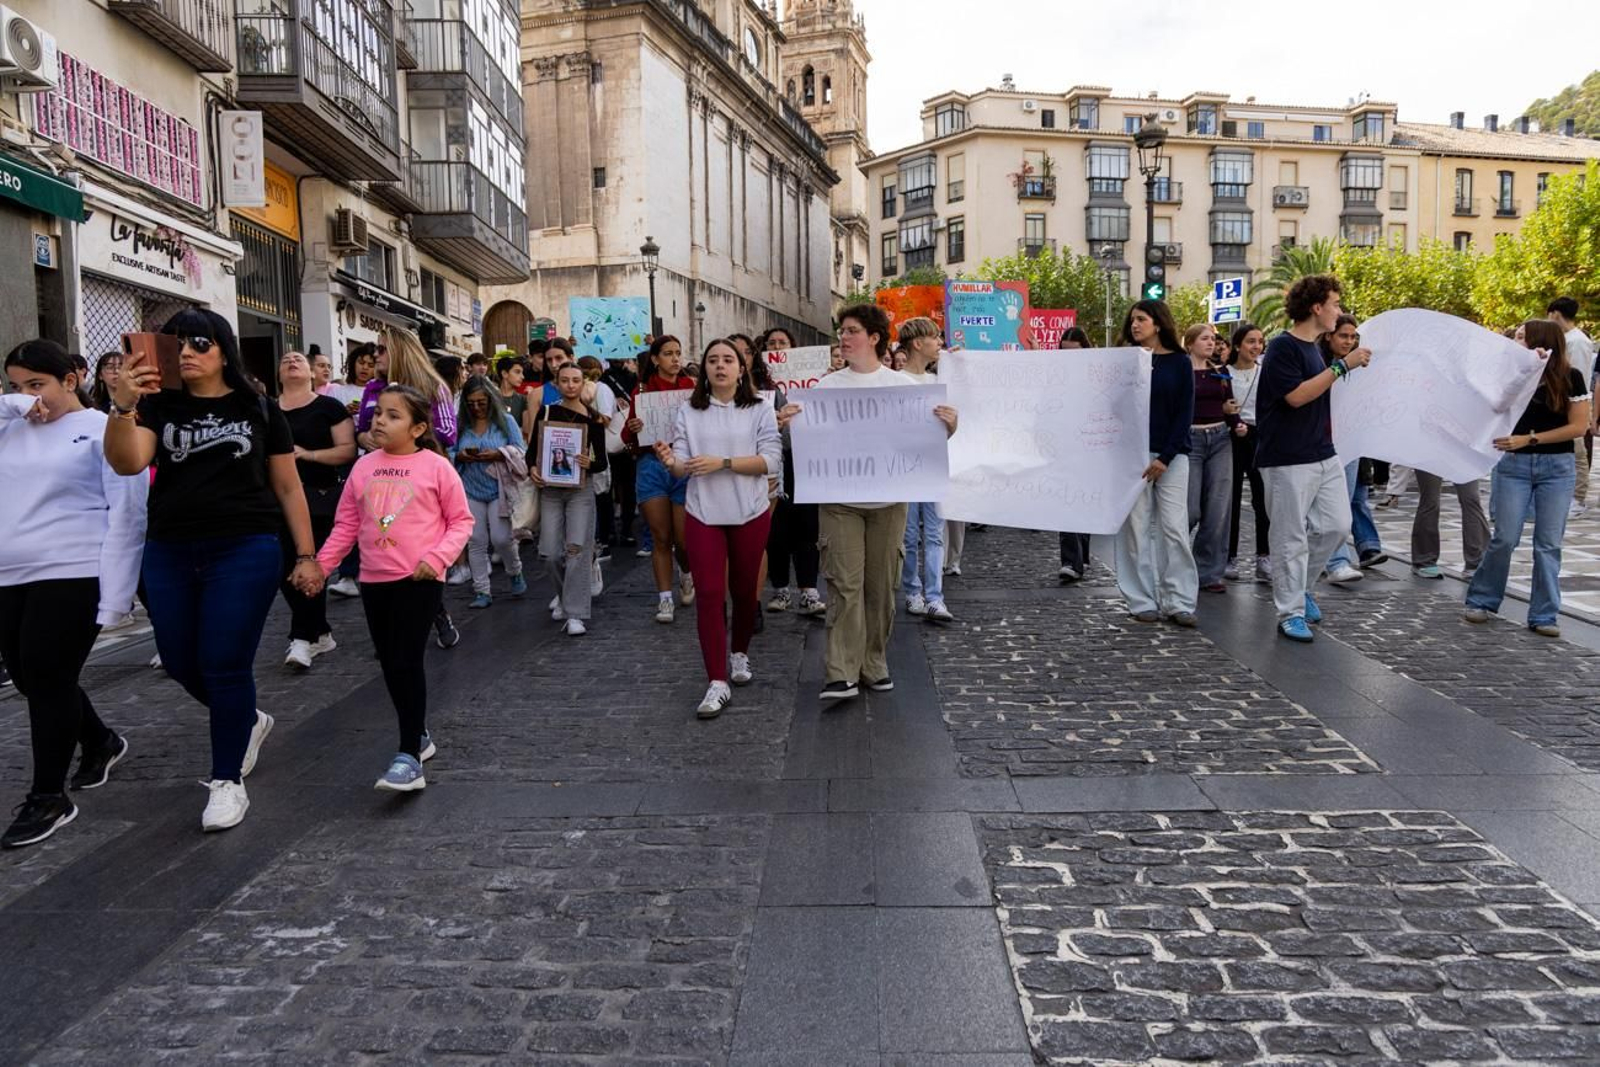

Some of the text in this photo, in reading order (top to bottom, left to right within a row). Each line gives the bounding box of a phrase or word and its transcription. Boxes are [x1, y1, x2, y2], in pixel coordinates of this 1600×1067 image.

[111, 214, 132, 242] La
[112, 252, 187, 284] EXCLUSIVE ARTISAN TASTE
[952, 283, 993, 293] HUMILLAR
[1222, 281, 1234, 299] P
[960, 316, 994, 326] FUERTE
[768, 352, 787, 364] NO
[162, 420, 253, 462] Queen
[372, 468, 412, 477] SPARKLE
[808, 458, 829, 479] NI
[837, 456, 876, 479] UNA
